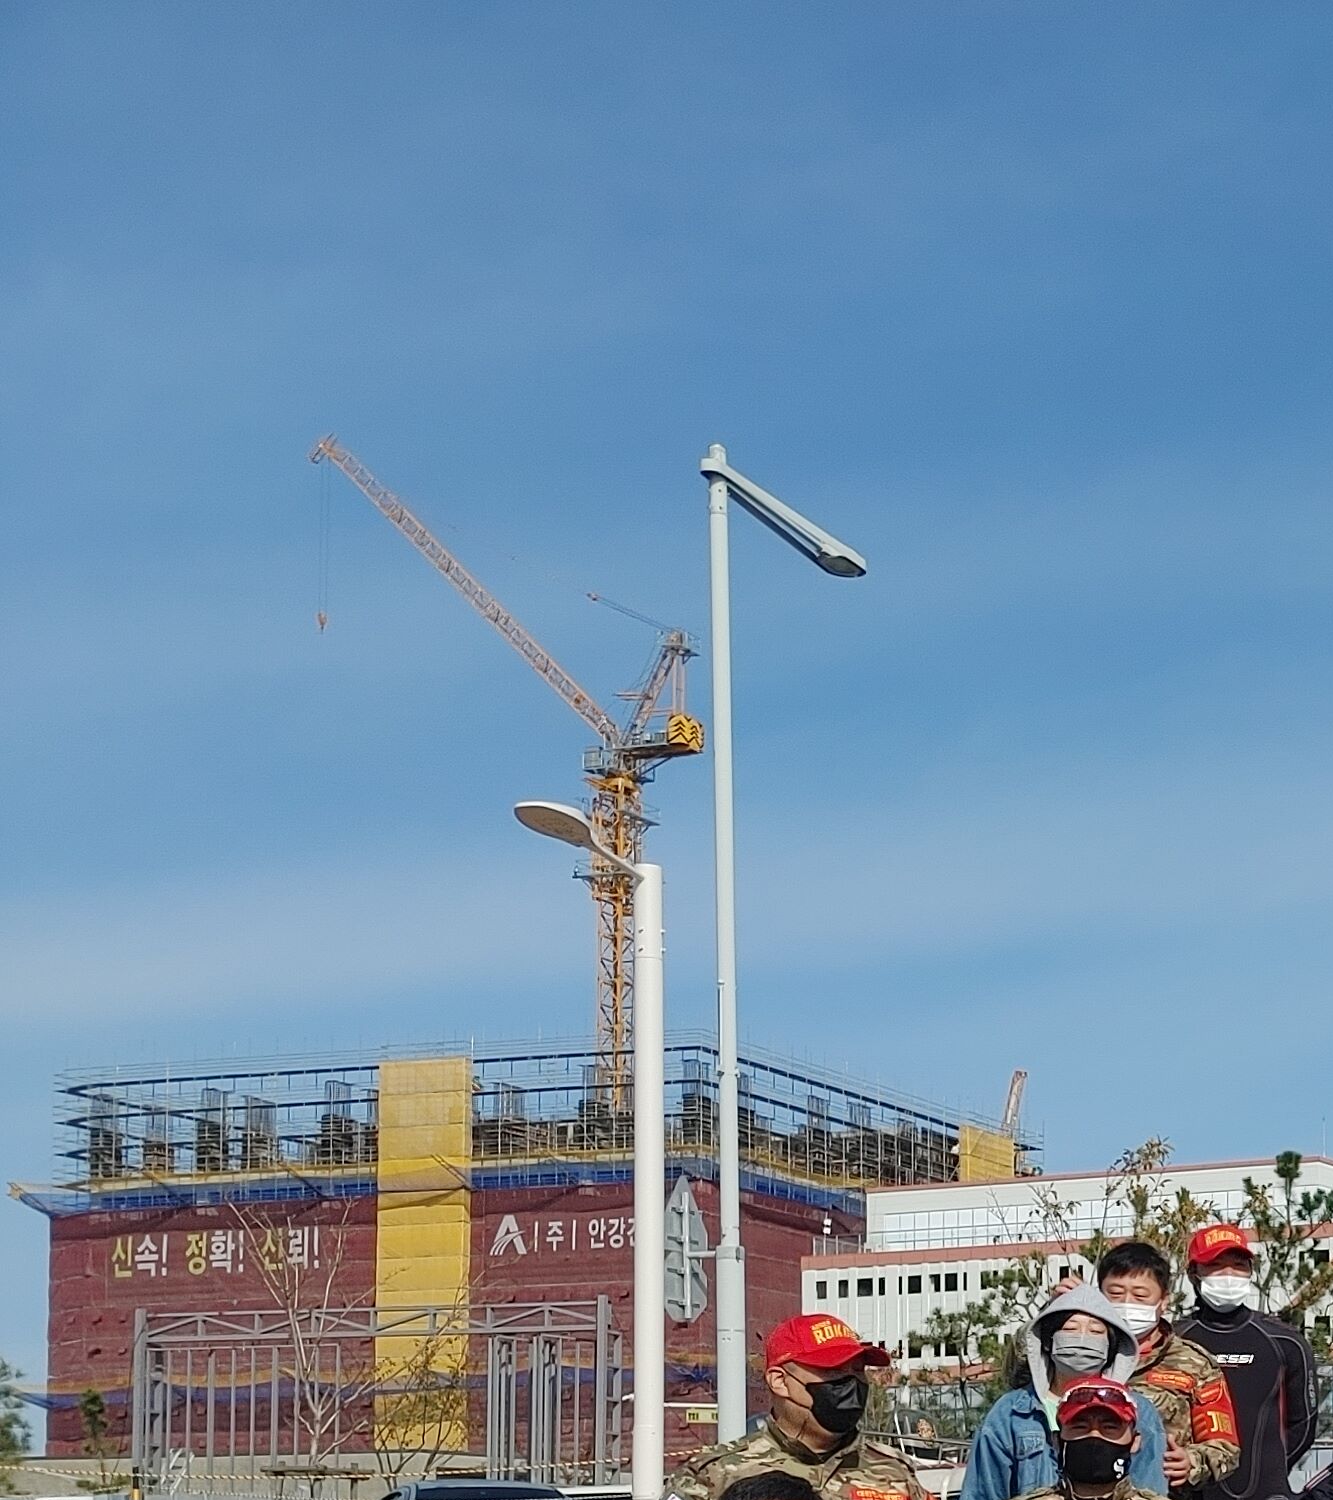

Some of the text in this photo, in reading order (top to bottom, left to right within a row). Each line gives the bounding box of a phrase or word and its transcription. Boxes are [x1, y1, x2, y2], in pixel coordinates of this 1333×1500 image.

[112, 1231, 168, 1278] 신속!
[185, 1229, 244, 1276] 정확!
[1213, 1353, 1255, 1365] ESSI
